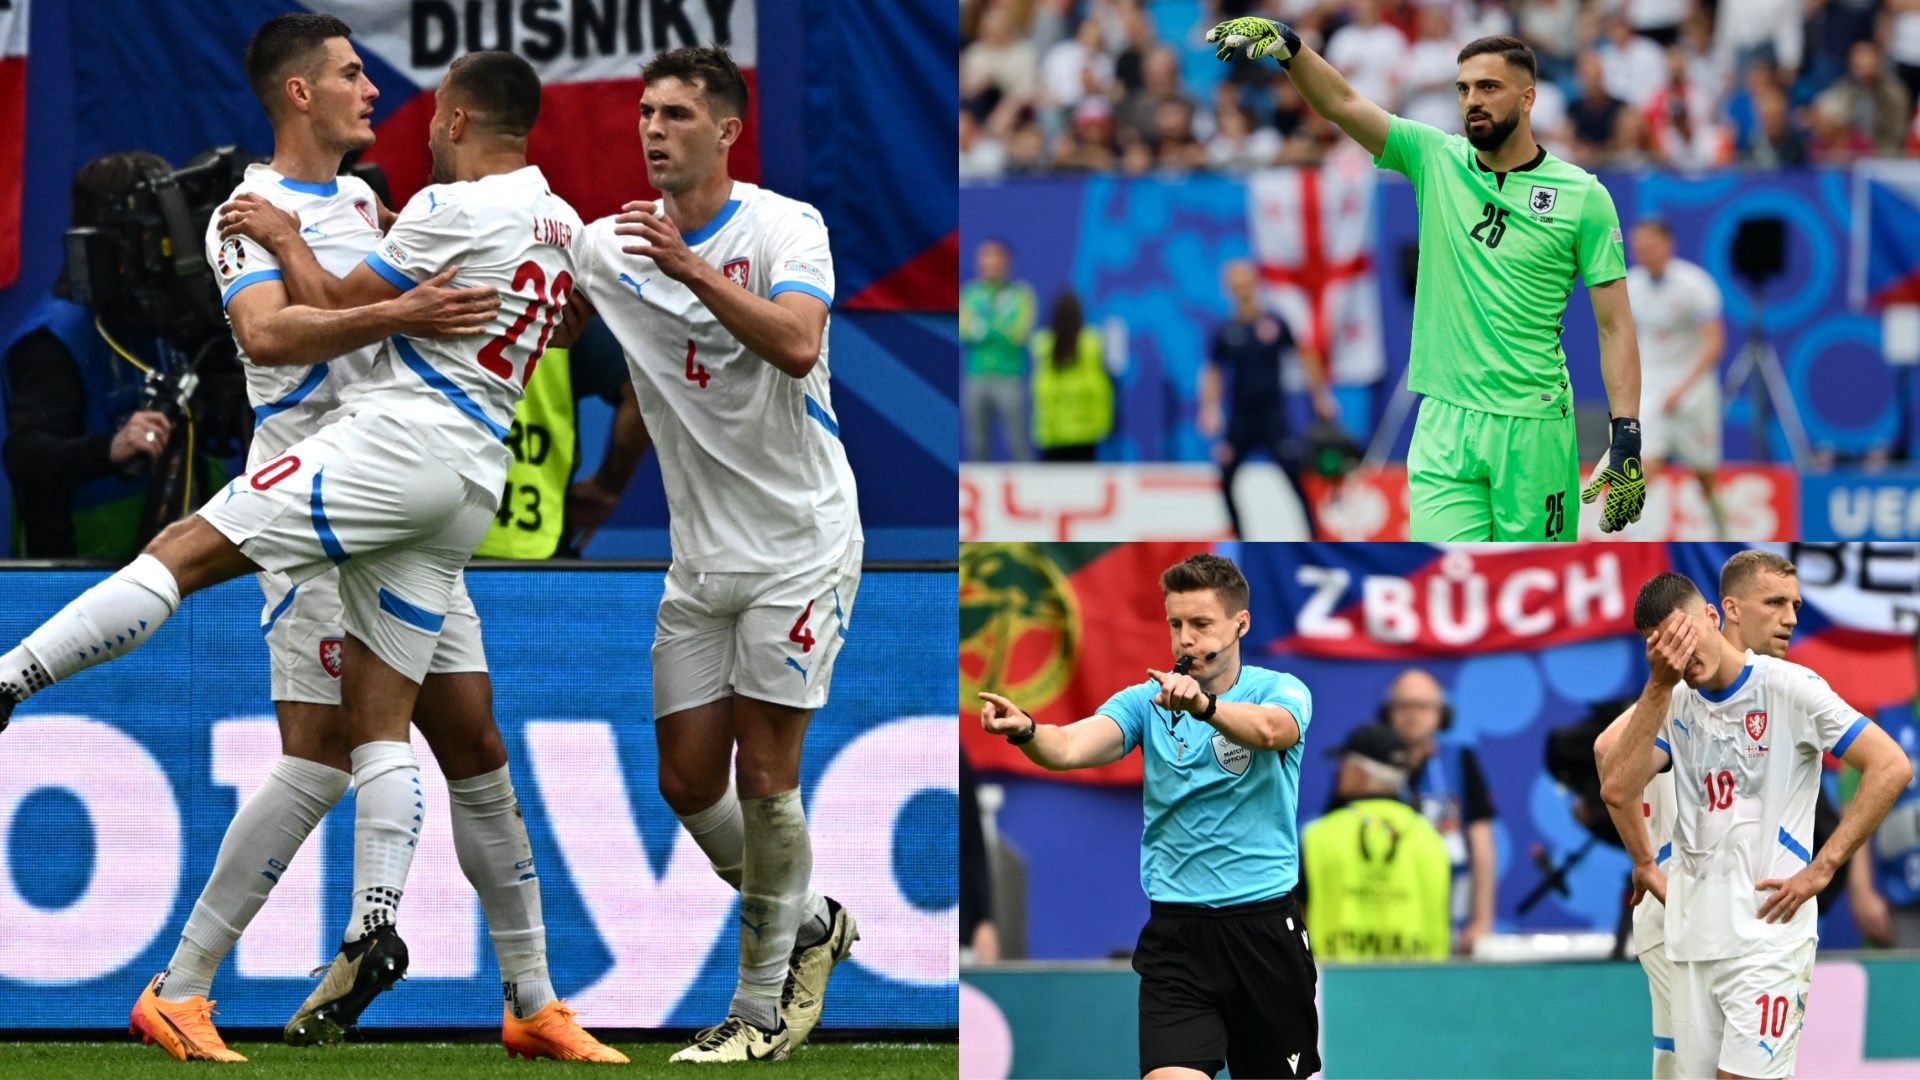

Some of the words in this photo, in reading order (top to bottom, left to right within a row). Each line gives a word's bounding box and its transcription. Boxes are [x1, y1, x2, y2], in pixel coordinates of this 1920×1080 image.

[534, 216, 572, 249] LINGR
[1469, 202, 1511, 249] 25
[685, 338, 711, 389] 4
[1545, 491, 1566, 539] 25
[1295, 551, 1626, 646] ZBŮCH
[789, 599, 816, 653] 4
[1223, 748, 1245, 758] MATCH
[1223, 754, 1249, 765] OFFICIAL
[1704, 770, 1735, 812] 10
[1755, 993, 1789, 1038] 10
